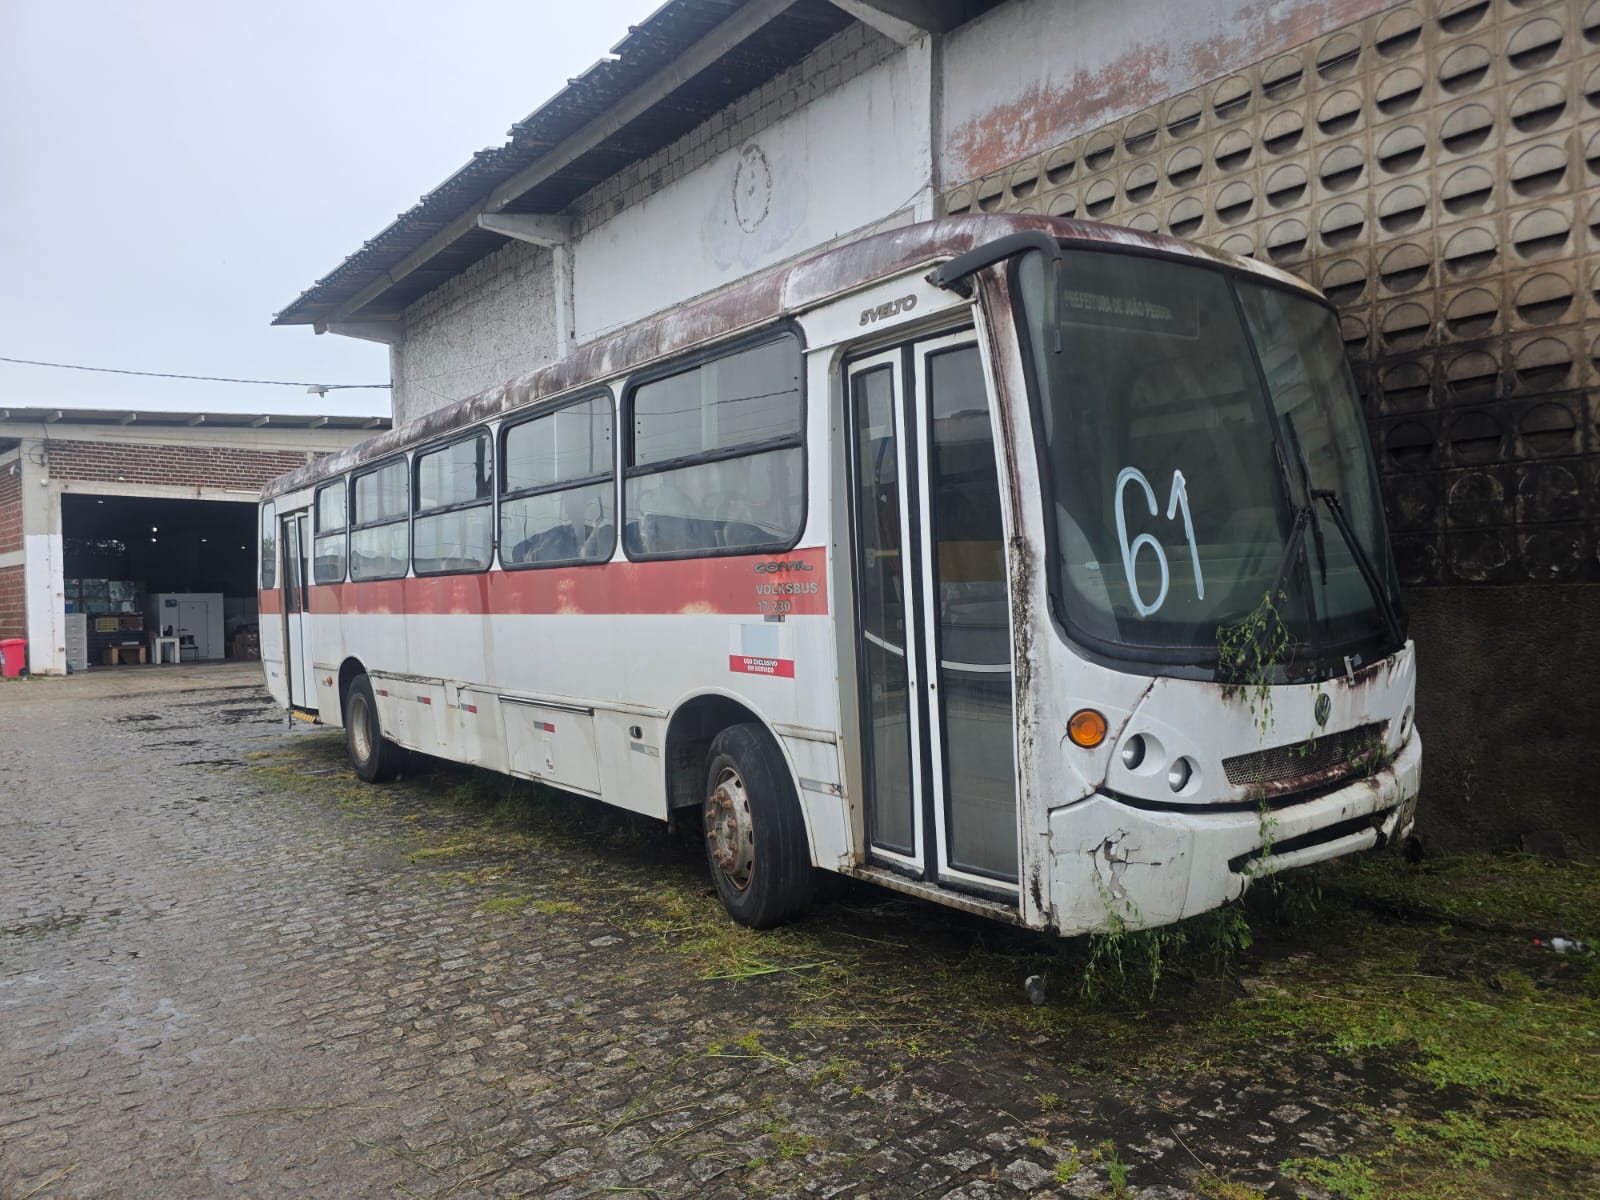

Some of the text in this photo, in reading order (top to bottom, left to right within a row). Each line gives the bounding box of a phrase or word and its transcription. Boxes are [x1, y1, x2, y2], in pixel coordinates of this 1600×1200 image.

[859, 294, 918, 326] SVELTO
[1115, 466, 1204, 617] 61
[754, 560, 813, 574] COMIL
[756, 583, 818, 595] VOLKSBUS
[758, 601, 791, 613] 17-230
